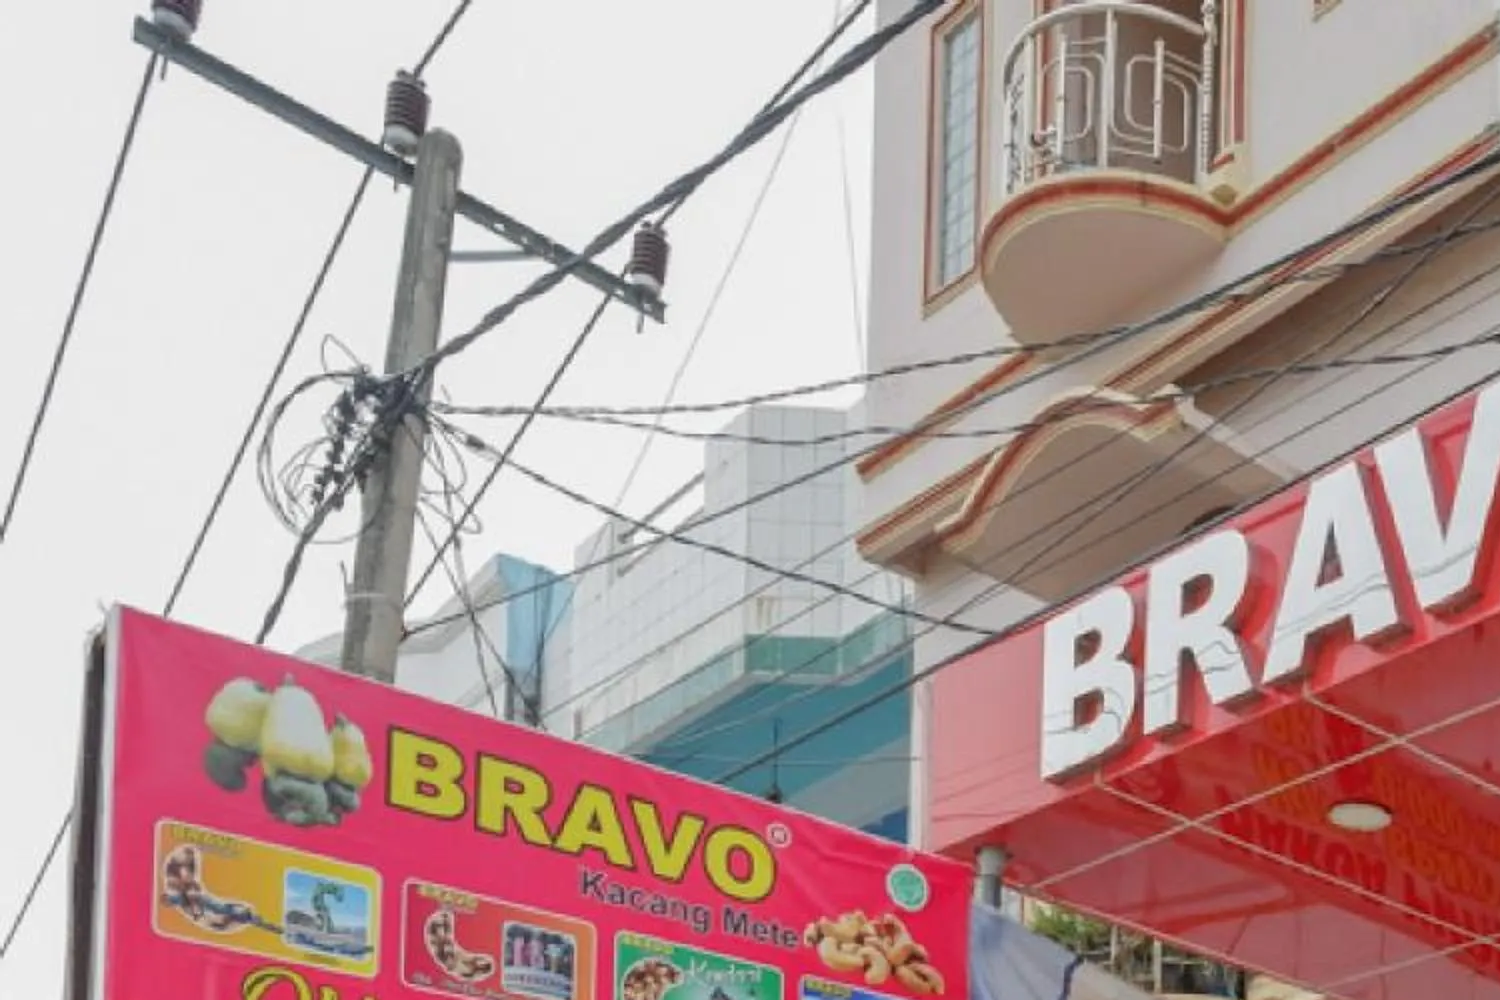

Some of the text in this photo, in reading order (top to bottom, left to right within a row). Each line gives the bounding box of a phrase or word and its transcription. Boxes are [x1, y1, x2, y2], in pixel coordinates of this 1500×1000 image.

[384, 724, 777, 904] BRAVO
[579, 867, 798, 950] Kacang Mete
